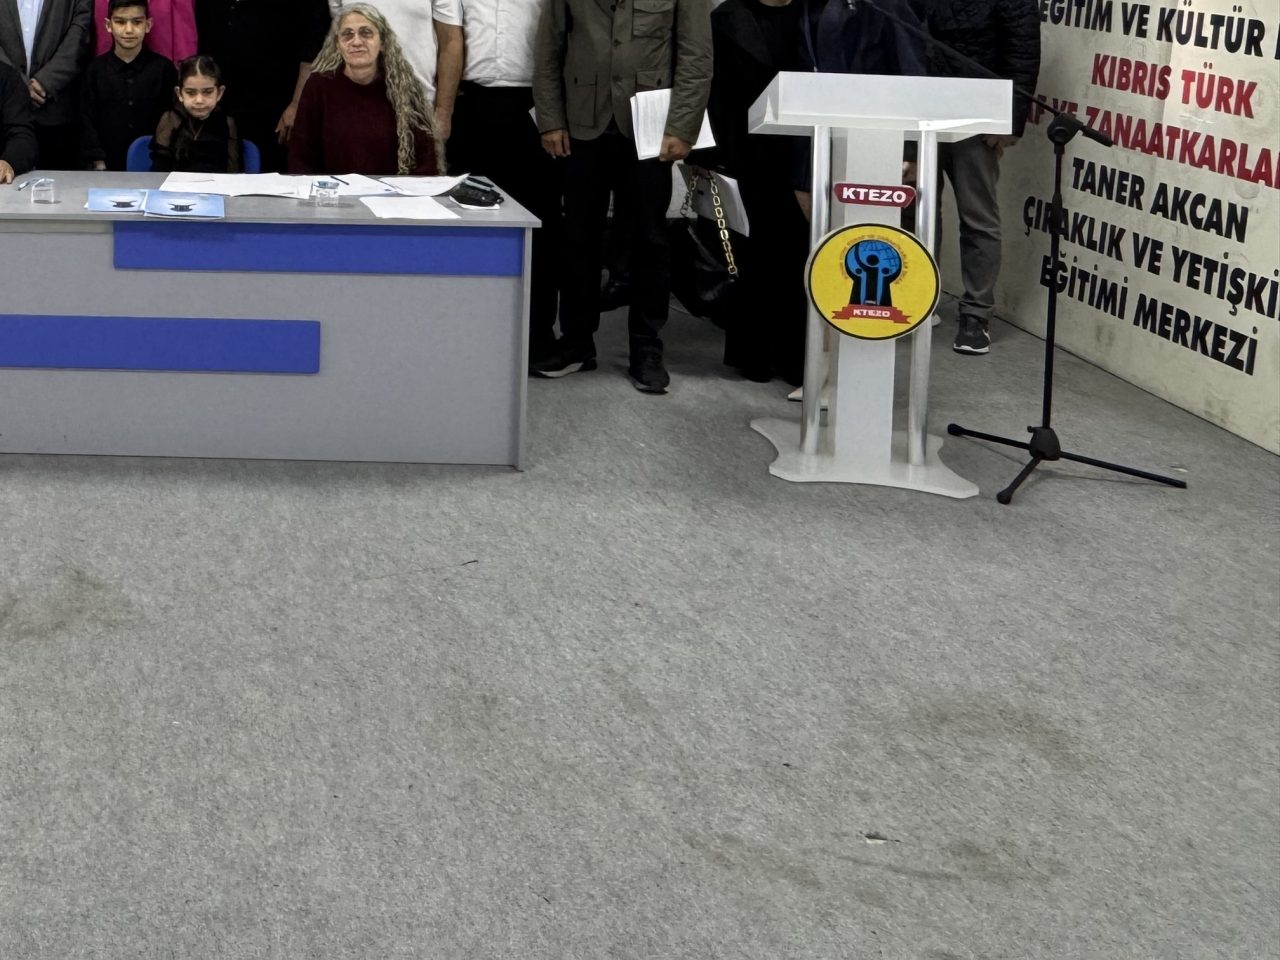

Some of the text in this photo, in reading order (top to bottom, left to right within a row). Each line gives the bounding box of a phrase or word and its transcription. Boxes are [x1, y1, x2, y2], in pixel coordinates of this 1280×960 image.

[1121, 2, 1150, 38] VE
[1156, 0, 1265, 57] KÜLTÜR
[1091, 53, 1257, 119] KIBRIS TÜRK
[842, 187, 906, 203] KTEZO
[1072, 157, 1248, 243] TANER AKCAN
[1132, 231, 1164, 276] VE
[1171, 245, 1280, 321] YETİŞKİ
[853, 309, 891, 318] KTEZO
[1040, 250, 1258, 376] EĞİTİMİ MERKEZİ
